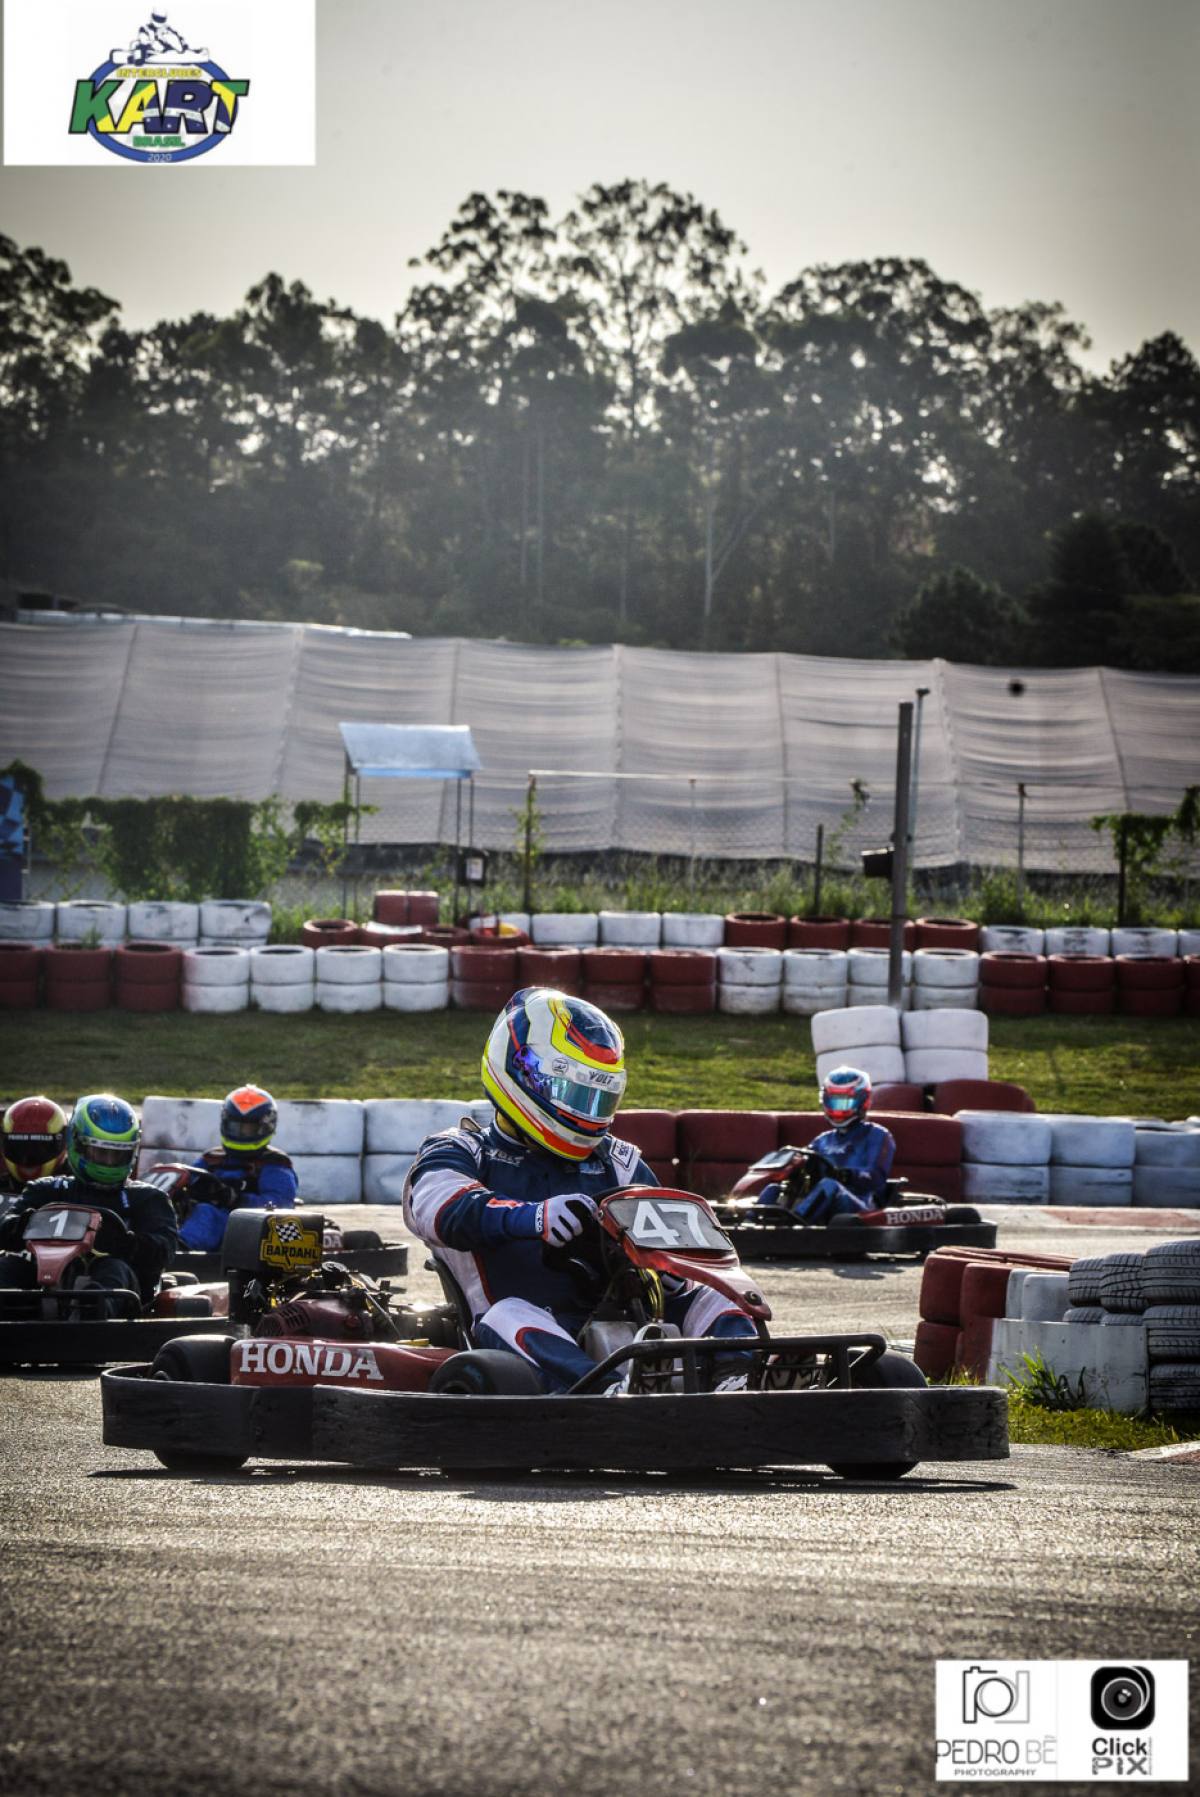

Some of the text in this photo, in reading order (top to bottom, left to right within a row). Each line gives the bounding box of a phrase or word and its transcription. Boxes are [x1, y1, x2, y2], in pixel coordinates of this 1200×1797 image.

[48, 1209, 69, 1237] 1
[633, 1201, 711, 1247] 47
[886, 1208, 944, 1225] HONDA
[266, 1243, 321, 1260] BARDAHL
[239, 1342, 385, 1381] HONDA
